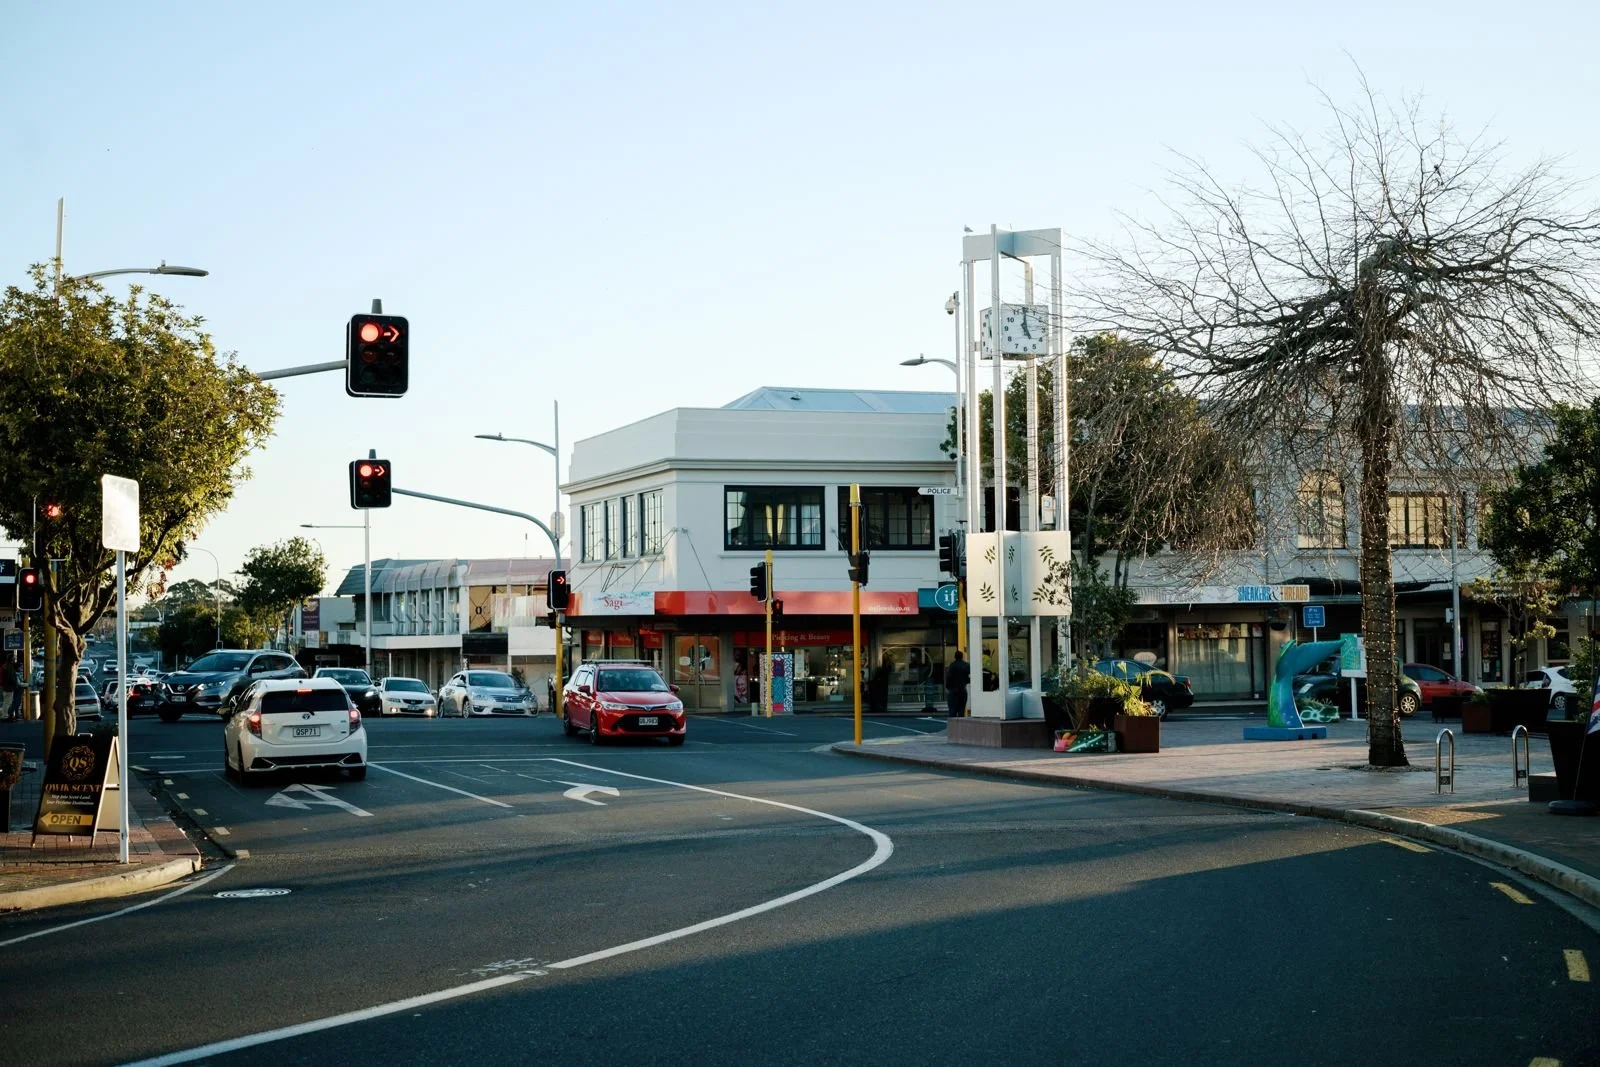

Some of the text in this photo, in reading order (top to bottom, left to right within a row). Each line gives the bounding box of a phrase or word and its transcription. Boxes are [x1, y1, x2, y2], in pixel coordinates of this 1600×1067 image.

[1239, 586, 1270, 601] SNEAKERS
[1280, 586, 1308, 600] THREADS
[603, 596, 624, 610] Sagi
[799, 633, 806, 641] &
[808, 632, 831, 641] Beauty
[295, 728, 317, 736] QSP71
[69, 759, 87, 772] QS
[45, 783, 102, 793] QWIK SCENT
[50, 814, 82, 825] OPEN
